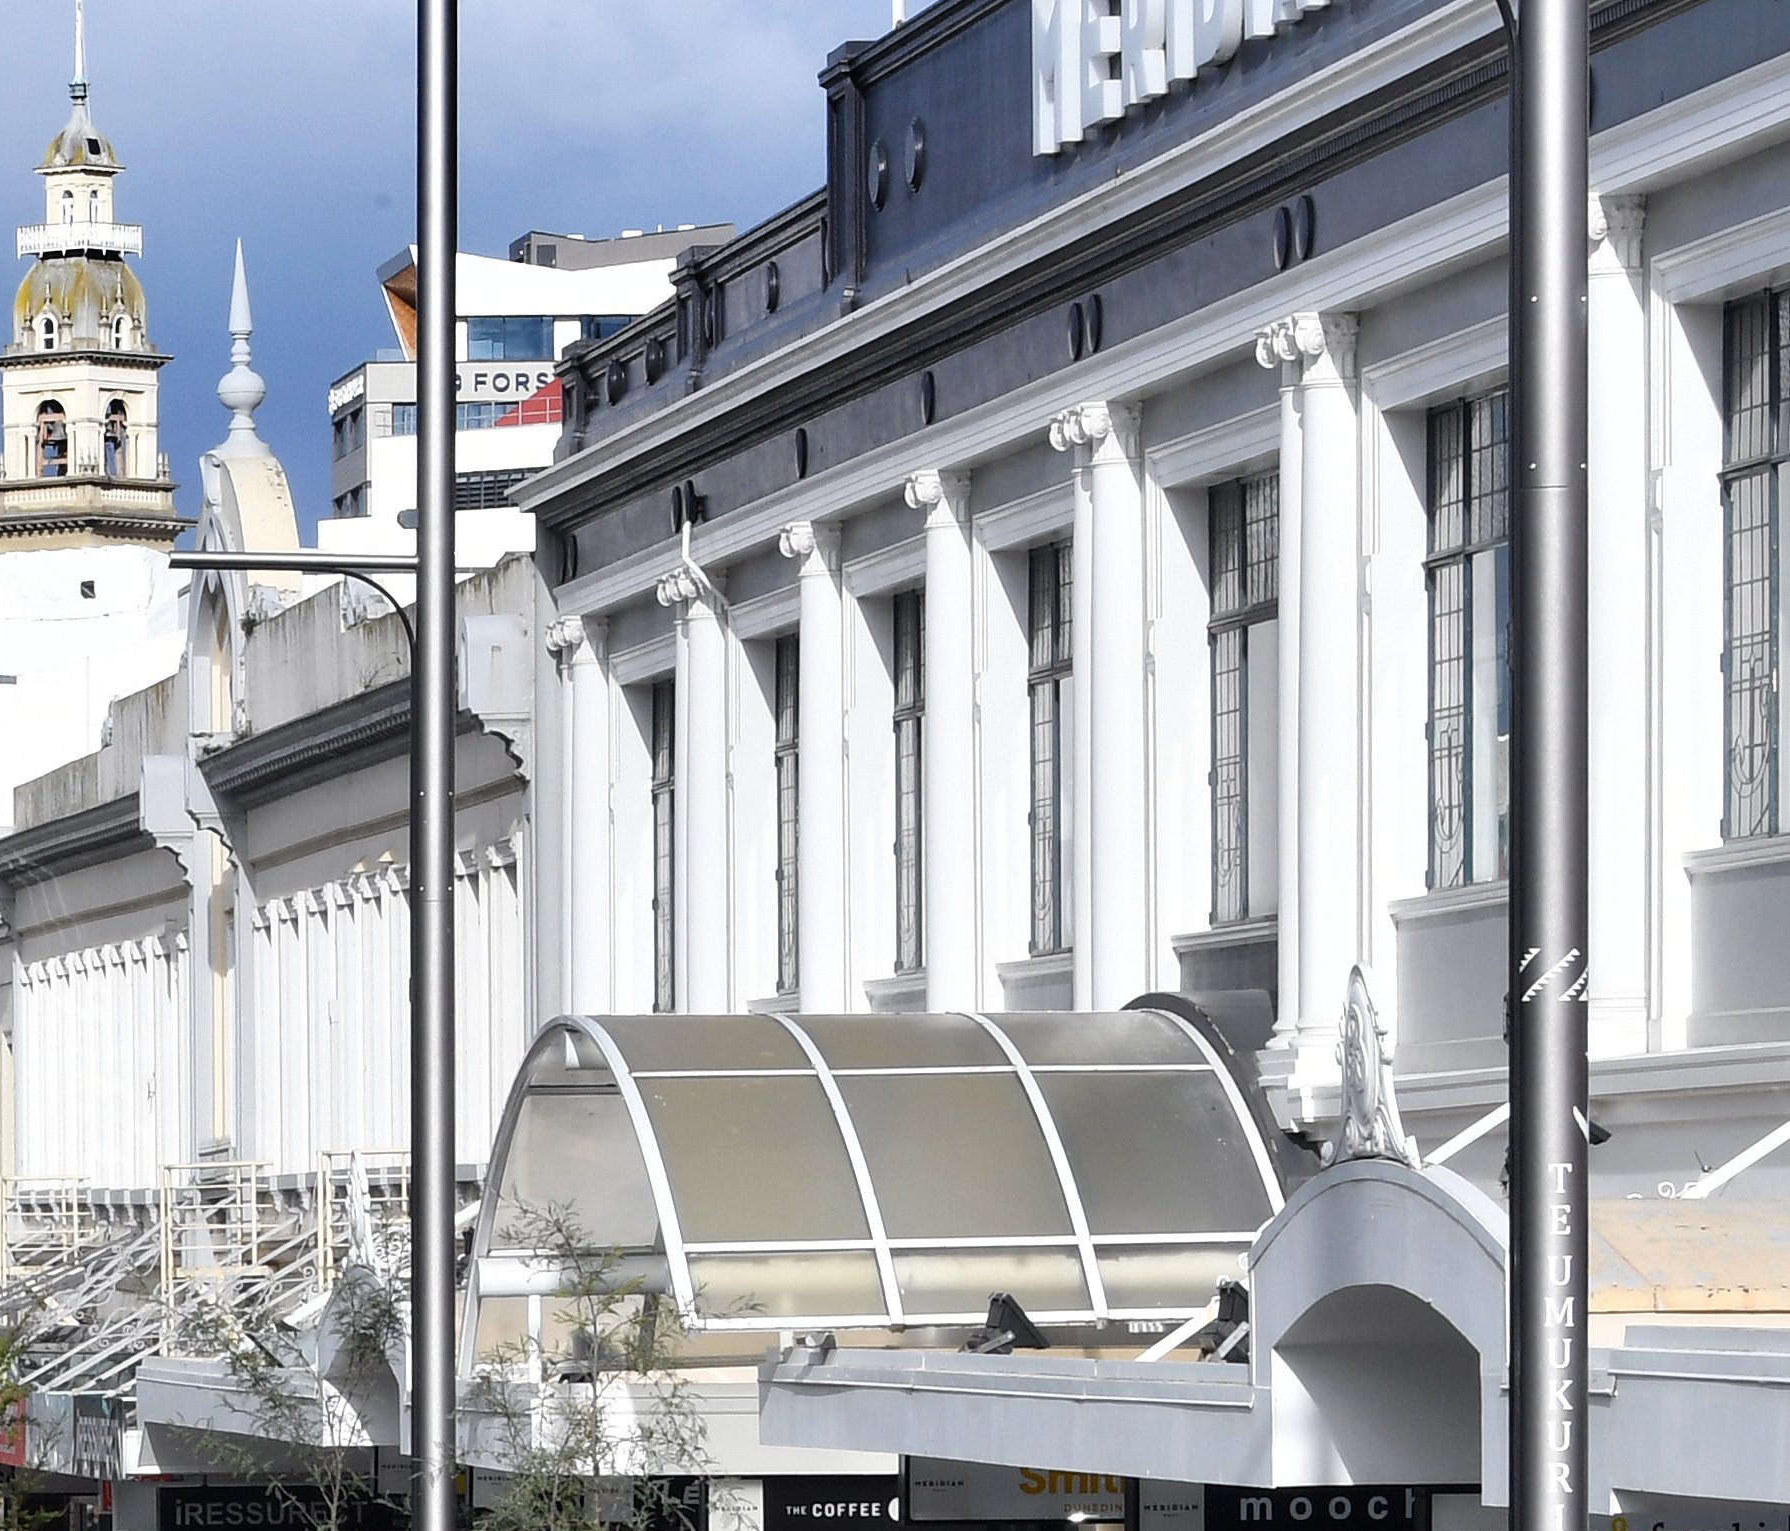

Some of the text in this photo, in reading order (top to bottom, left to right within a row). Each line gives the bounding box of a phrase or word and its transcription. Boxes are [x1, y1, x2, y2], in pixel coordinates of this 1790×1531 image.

[474, 372, 558, 393] FORS
[914, 1480, 965, 1488] MERIDIAN
[786, 1502, 881, 1518] THE COFFEE
[1143, 1504, 1200, 1512] MERIDIAN
